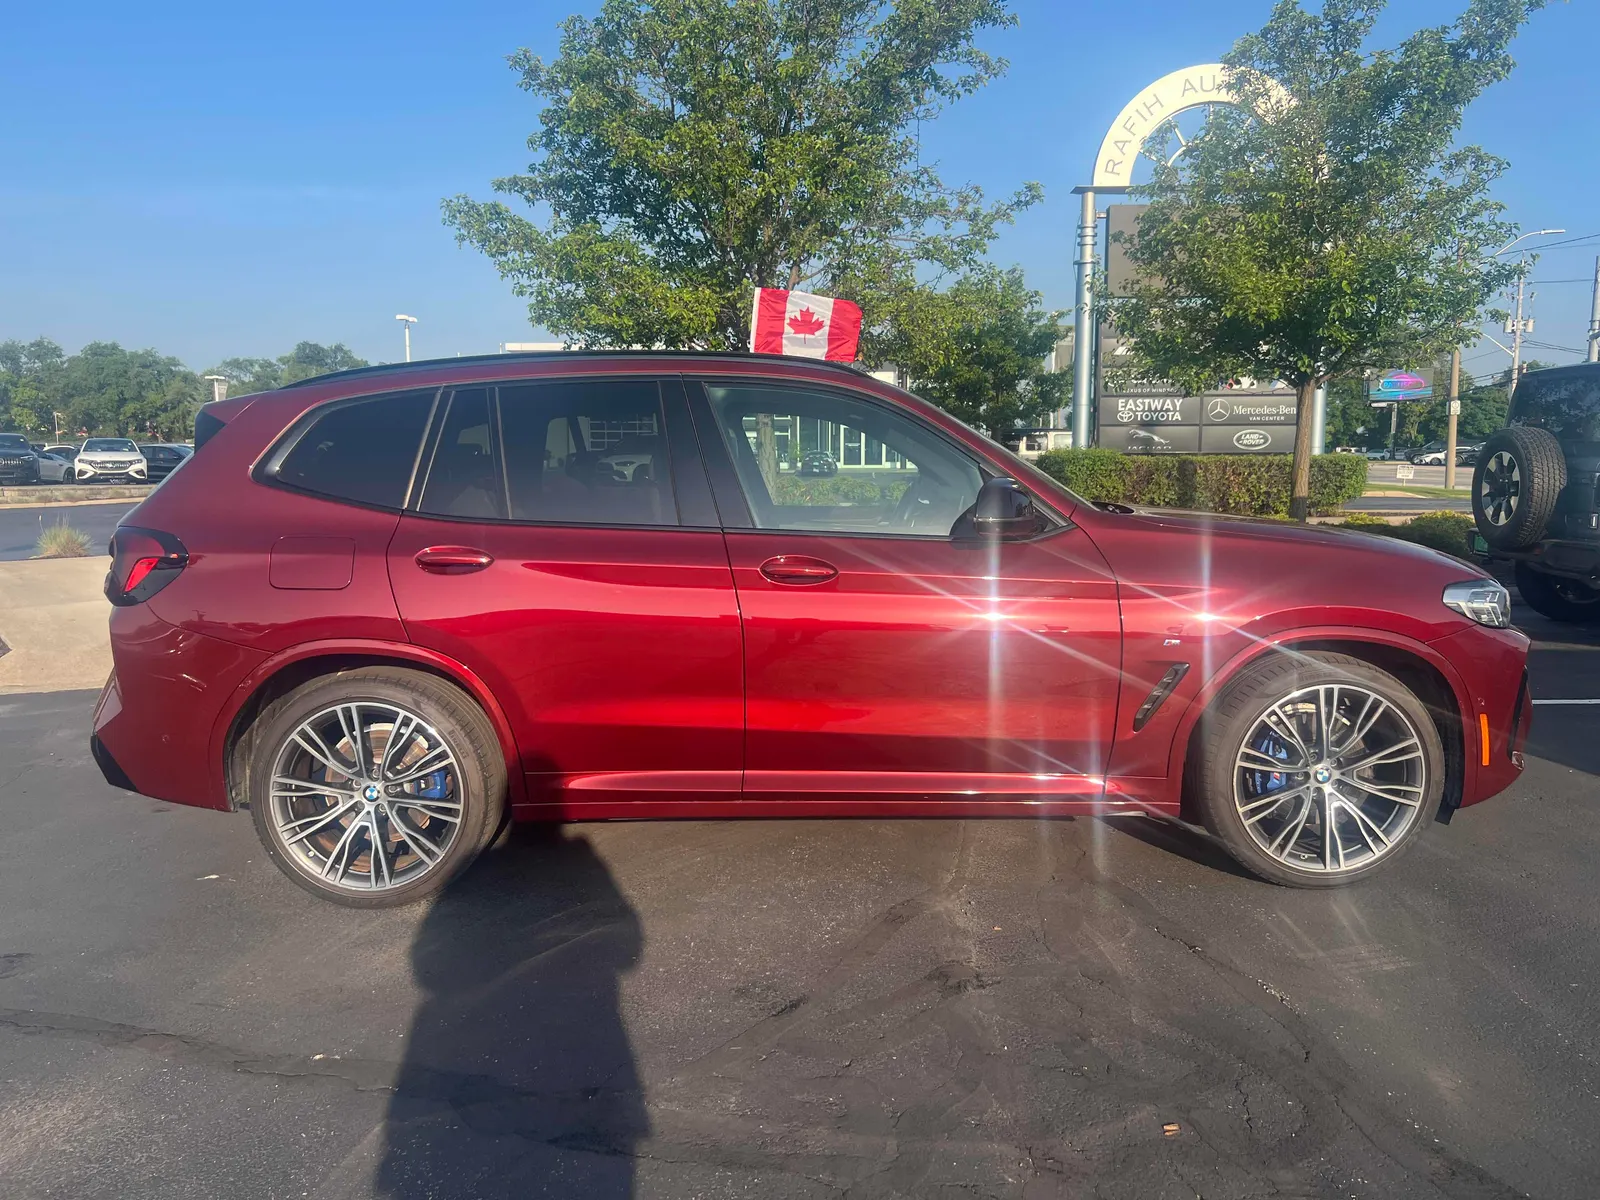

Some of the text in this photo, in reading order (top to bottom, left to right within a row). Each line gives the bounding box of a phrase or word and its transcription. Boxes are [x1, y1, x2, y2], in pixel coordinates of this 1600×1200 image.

[1104, 74, 1217, 177] RAFIH AU
[1118, 399, 1183, 411] EASTWAY
[1233, 405, 1297, 415] Mercedes-Ben
[1136, 412, 1182, 421] TOYOTA
